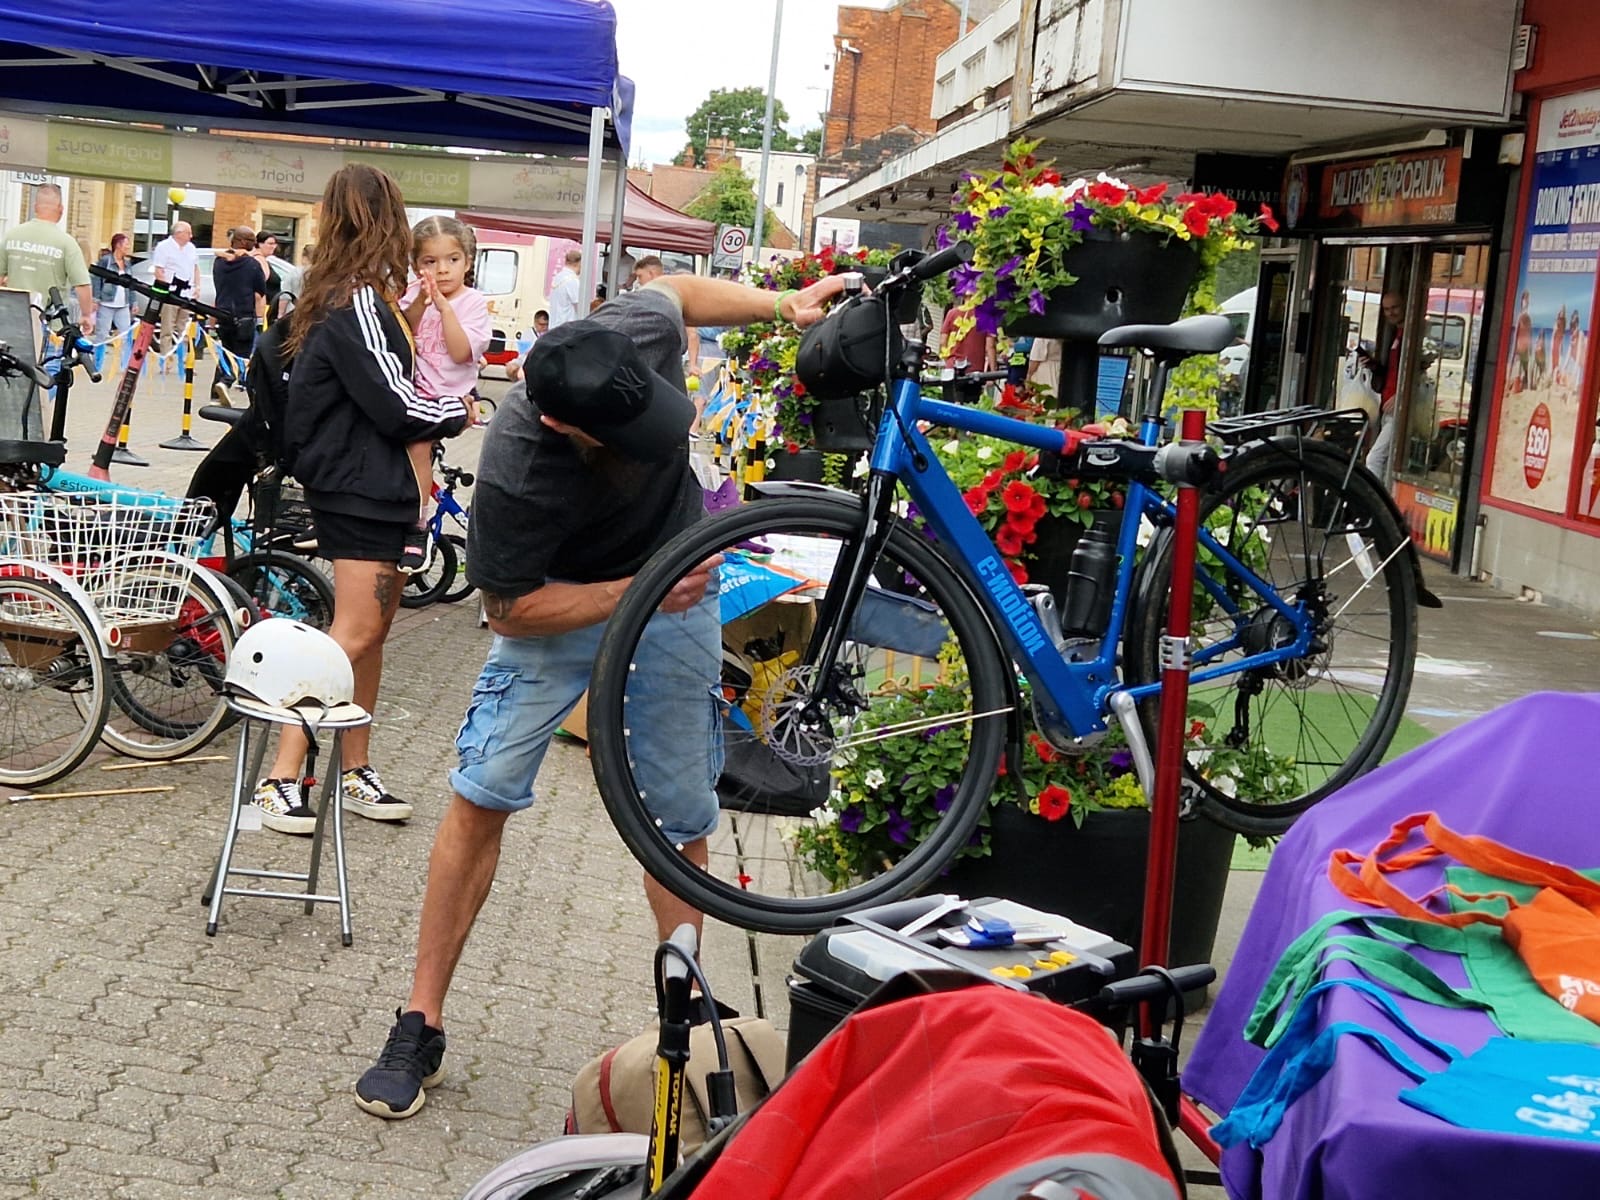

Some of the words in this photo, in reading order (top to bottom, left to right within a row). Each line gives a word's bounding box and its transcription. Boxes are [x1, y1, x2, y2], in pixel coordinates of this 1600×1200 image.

[16, 171, 48, 182] ENDS
[1330, 167, 1377, 207] MILITARY
[1377, 158, 1446, 203] EMPORIUM
[1535, 187, 1573, 226] BOOKING
[725, 235, 743, 247] 30
[1526, 425, 1550, 457] £60
[976, 555, 1046, 657] e-motion
[669, 1070, 681, 1136] TOPEAK
